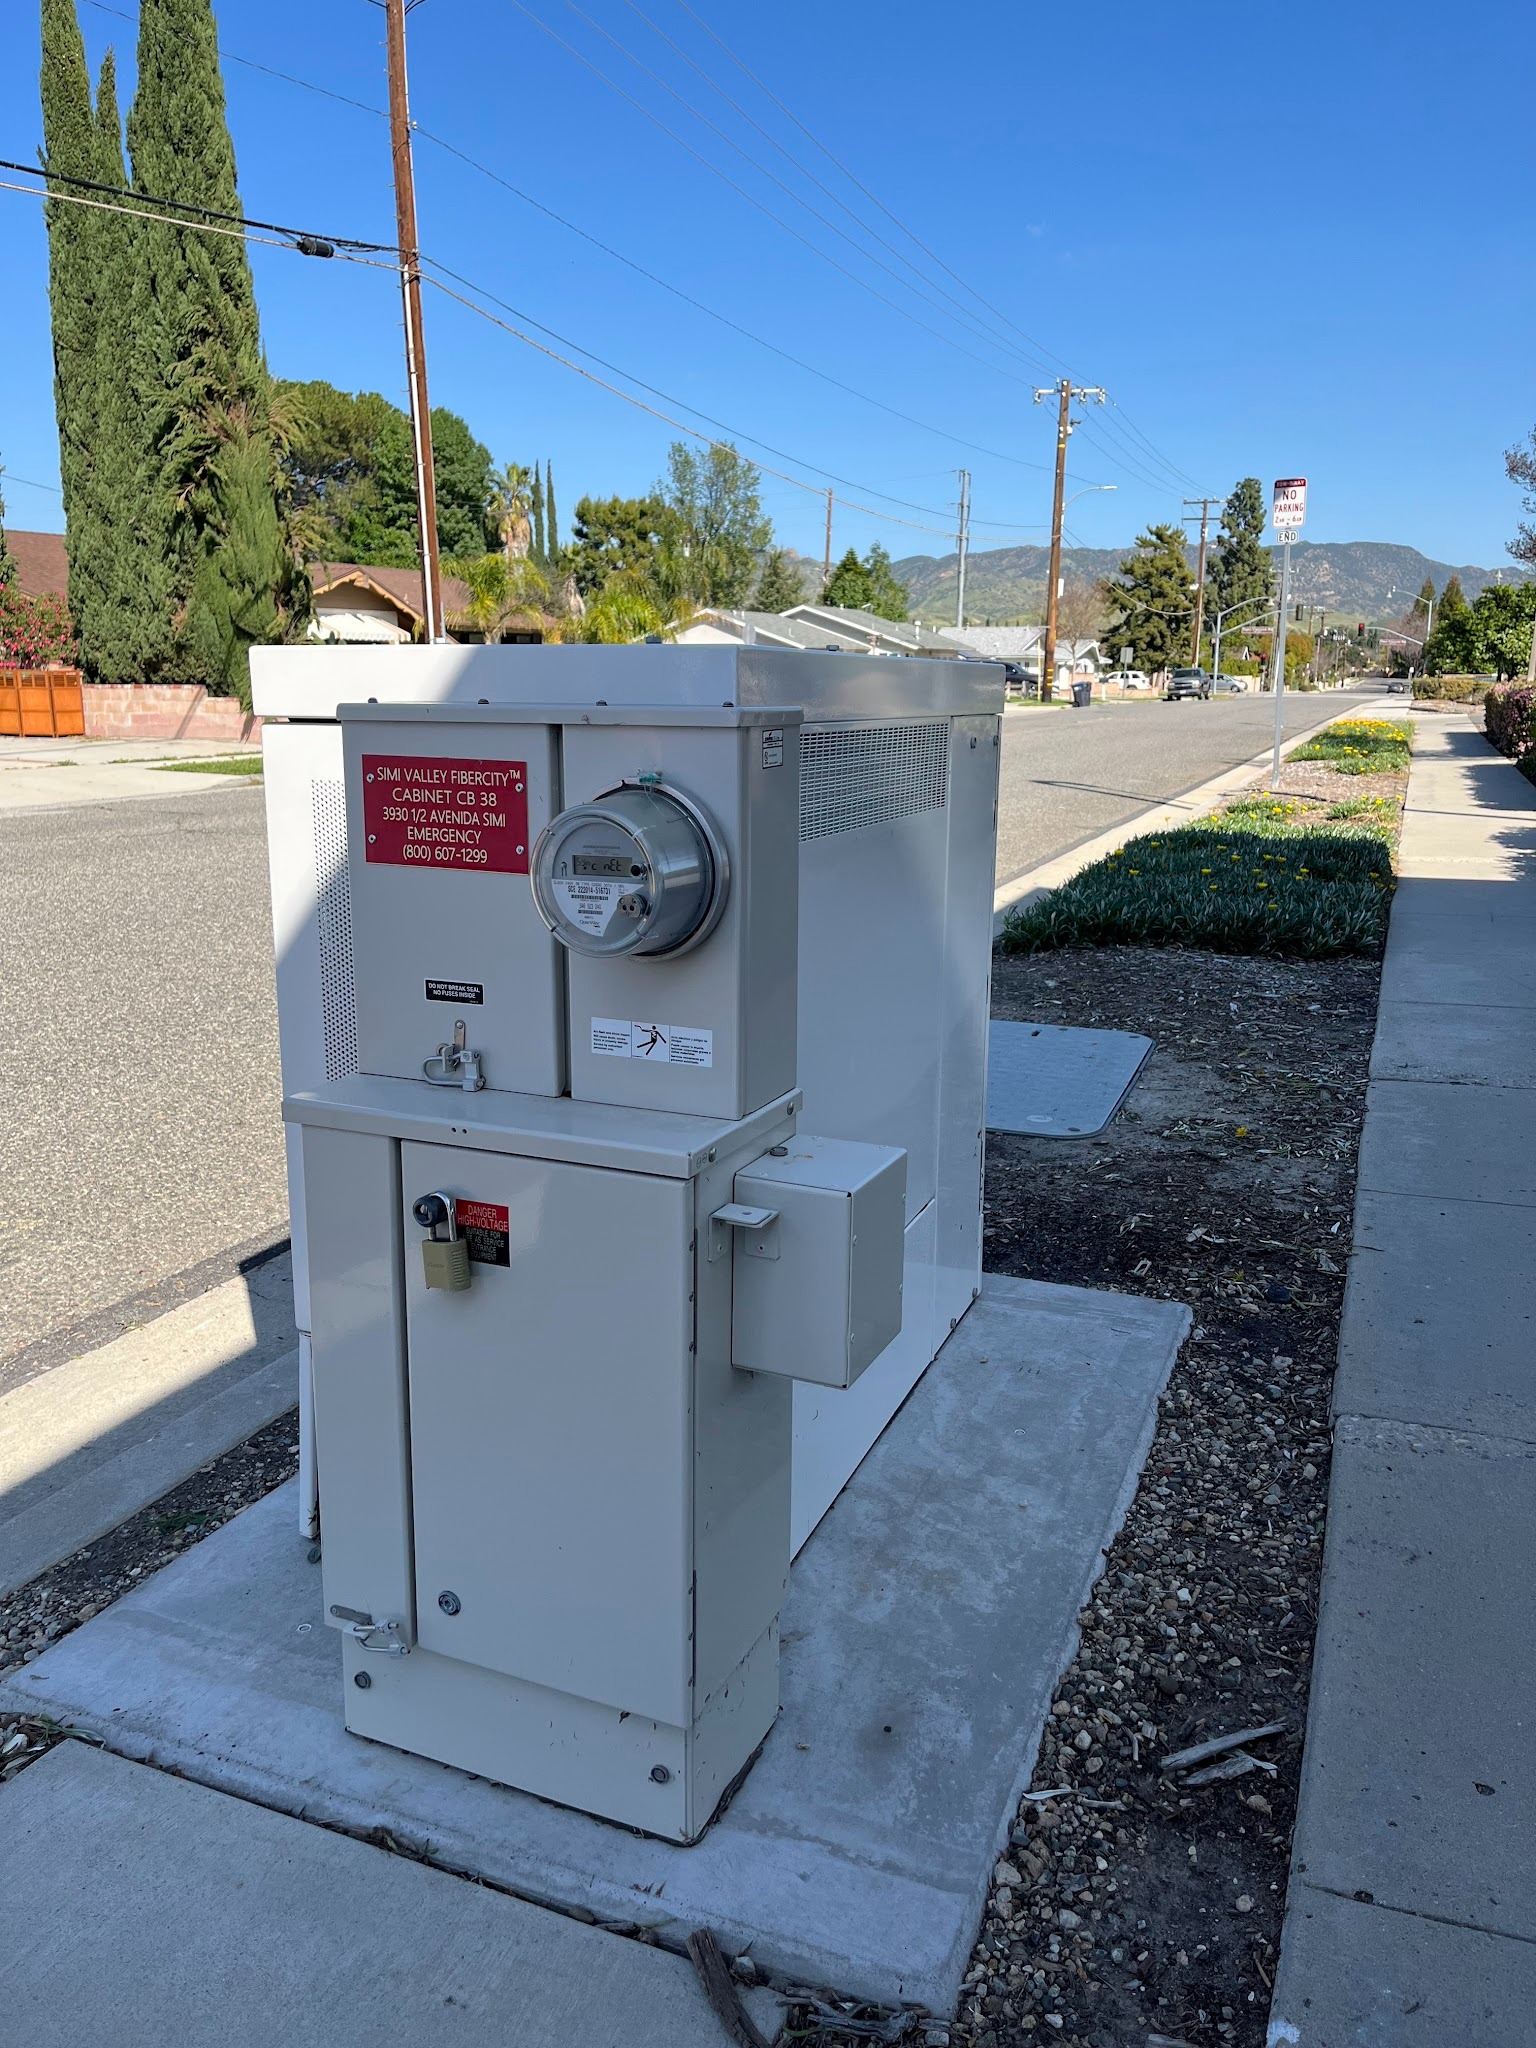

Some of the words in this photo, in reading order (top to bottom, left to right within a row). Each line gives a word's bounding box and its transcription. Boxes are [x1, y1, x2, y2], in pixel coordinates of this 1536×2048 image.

[1282, 490, 1297, 500] NO
[1275, 503, 1304, 513] PARKING
[1279, 532, 1296, 542] END
[377, 767, 401, 781] SIMI
[404, 768, 447, 784] VALLEY
[392, 788, 452, 804] CABINET
[456, 791, 476, 806] CB
[480, 792, 497, 806] 38
[383, 807, 409, 821] 3930
[411, 808, 427, 823] 1/2
[430, 810, 480, 826] AVENIDA
[483, 812, 506, 828] SIMI
[407, 826, 481, 844] EMERGENCY
[403, 844, 431, 861] (800)
[435, 846, 488, 863] 607-1299
[448, 984, 465, 992] BREAK
[468, 1204, 497, 1219] DANGER
[457, 1214, 508, 1231] HIGH-VOLTAGE
[466, 1226, 488, 1238] SUITABLE
[490, 1230, 501, 1239] FOR
[475, 1235, 481, 1243] AS
[483, 1237, 504, 1248] SERVICE
